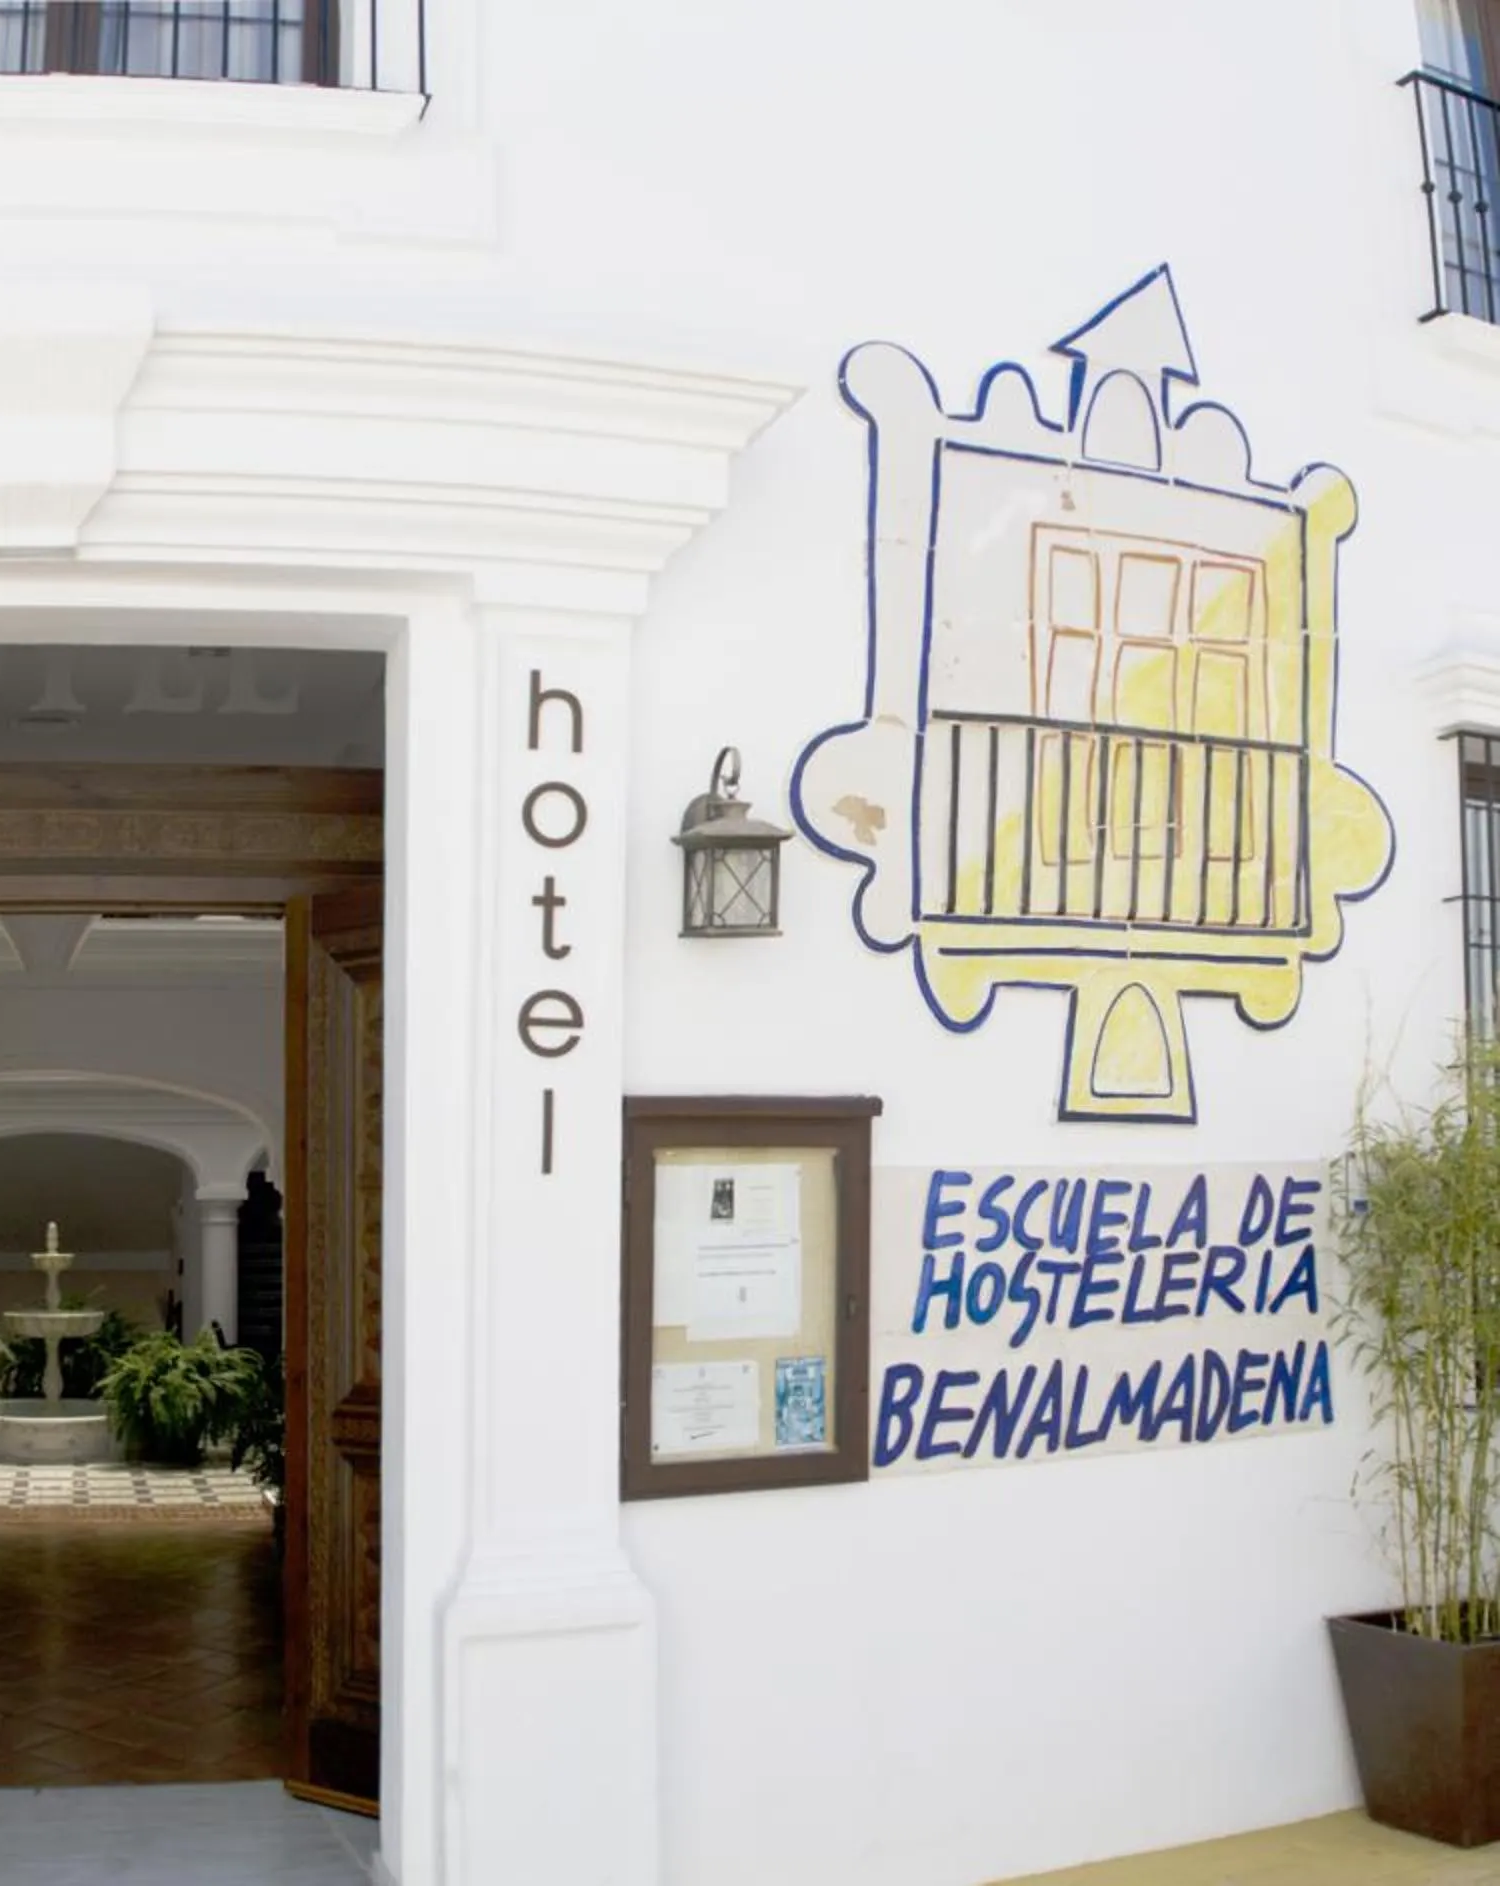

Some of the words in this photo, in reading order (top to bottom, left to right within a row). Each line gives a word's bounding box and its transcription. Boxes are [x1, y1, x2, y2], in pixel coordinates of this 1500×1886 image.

[517, 668, 589, 1176] hotel
[922, 1169, 1207, 1255] ESCUELA
[1238, 1173, 1322, 1248] DE
[911, 1243, 1320, 1349] HOSTELERIA
[872, 1339, 1335, 1468] BENALMADENA
